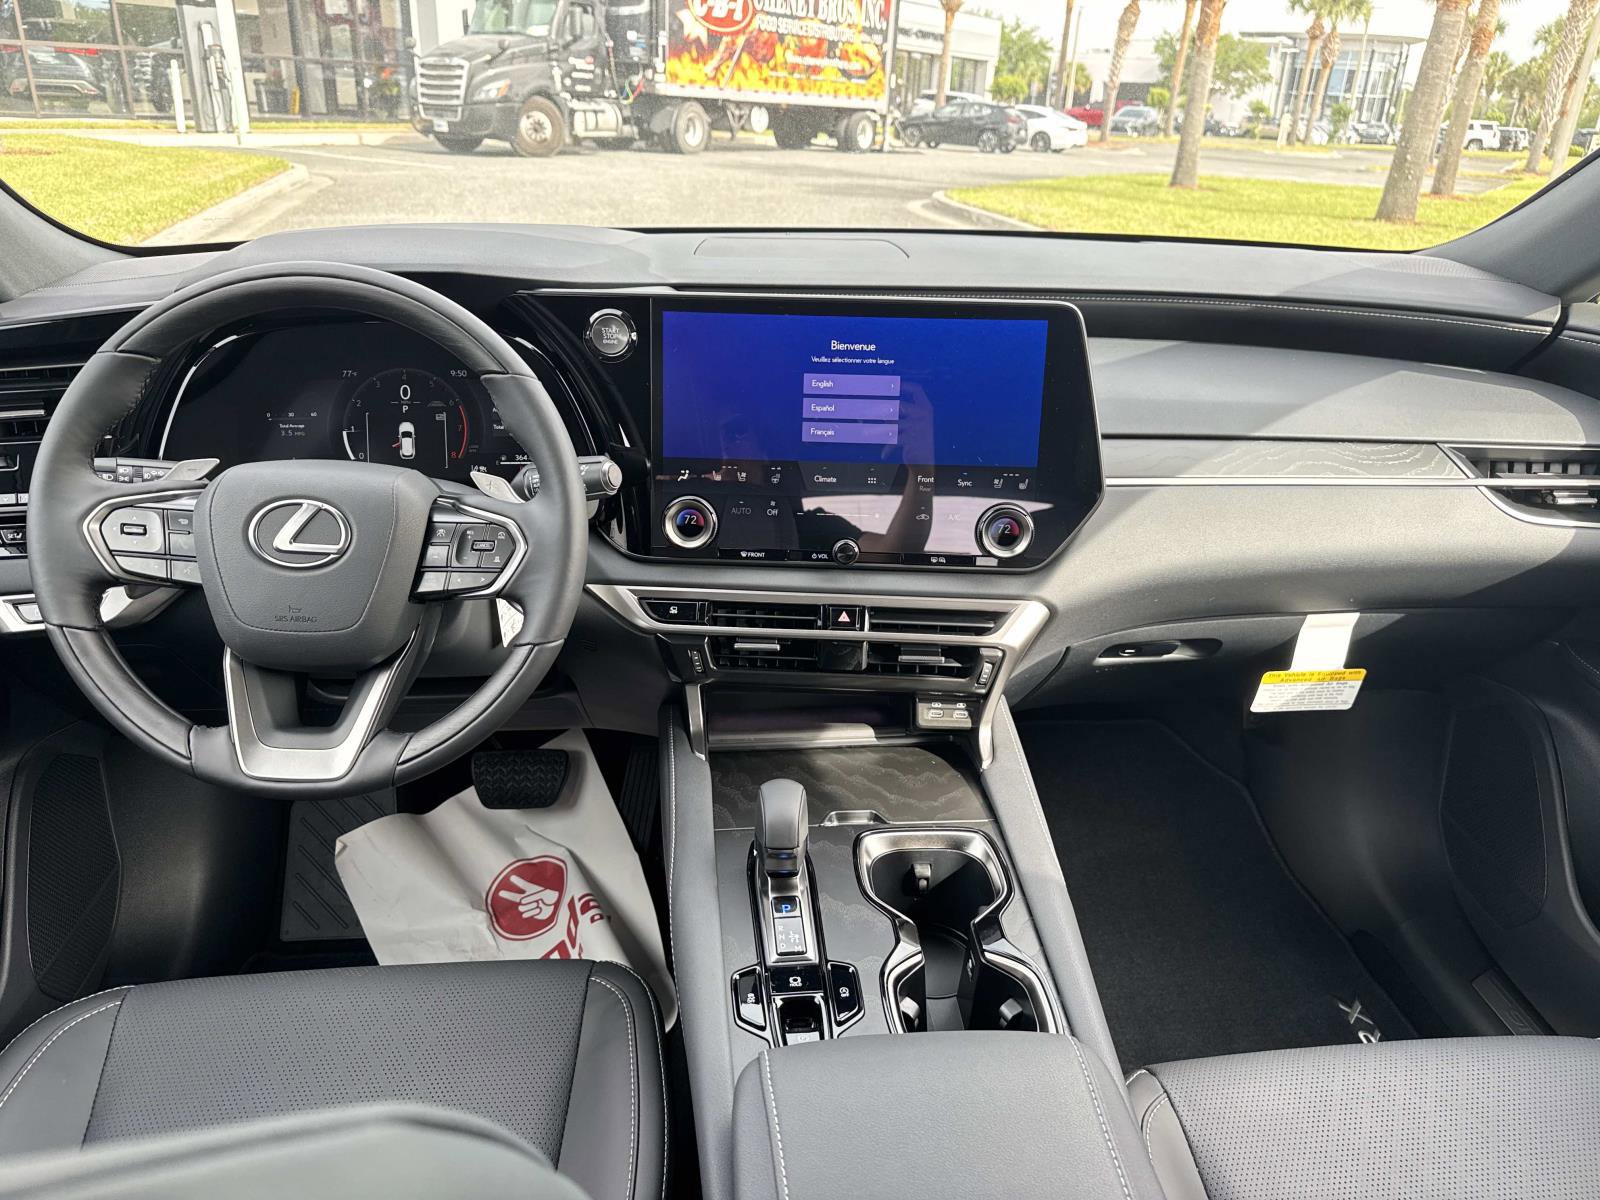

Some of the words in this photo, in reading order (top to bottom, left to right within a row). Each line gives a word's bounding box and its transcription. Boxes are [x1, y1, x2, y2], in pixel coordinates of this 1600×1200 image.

[831, 340, 876, 351] Bienvenue
[877, 357, 895, 366] langue
[811, 379, 834, 389] English
[399, 384, 411, 400] 0
[402, 405, 409, 413] P
[811, 403, 835, 413] Español
[810, 428, 835, 437] Français
[814, 475, 837, 483] Climate
[917, 475, 935, 483] Front
[957, 479, 973, 487] Sync
[731, 507, 752, 515] AUTO
[766, 508, 778, 516] Off
[684, 515, 697, 525] 72
[998, 524, 1011, 534] 72
[781, 904, 791, 914] P
